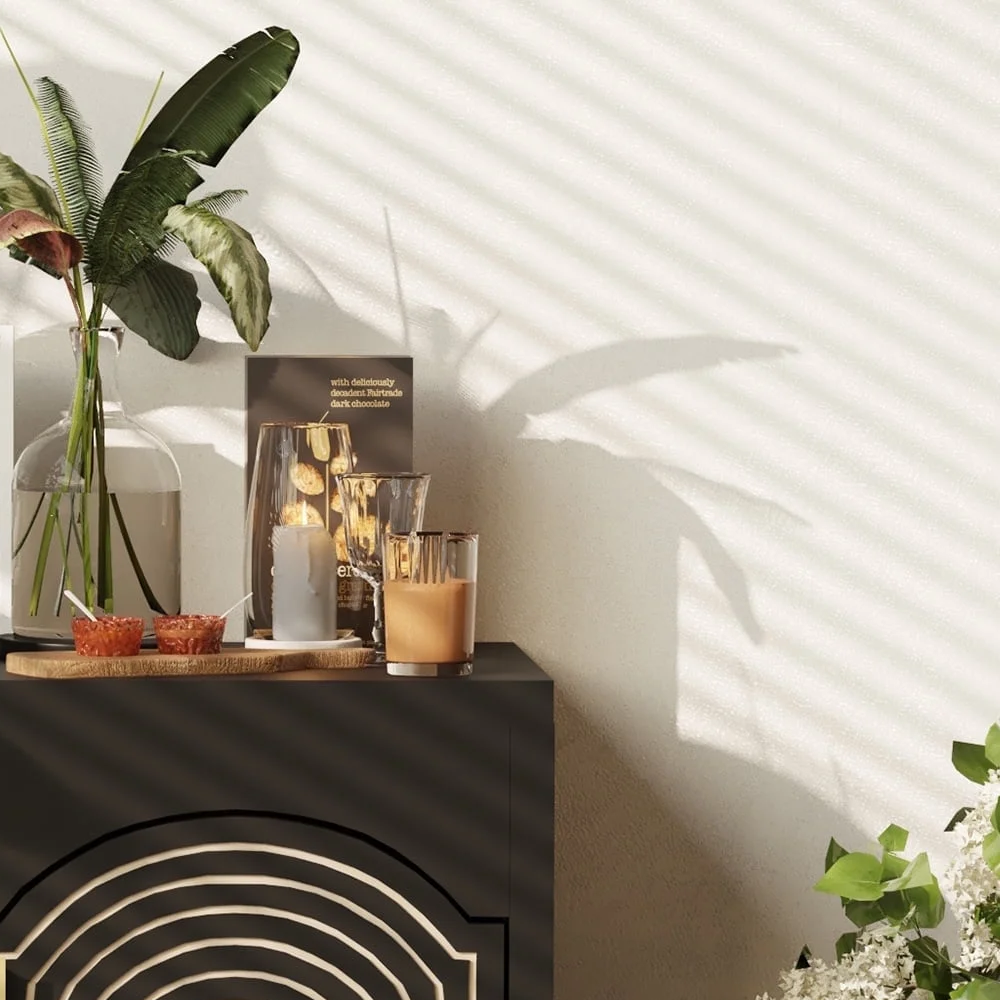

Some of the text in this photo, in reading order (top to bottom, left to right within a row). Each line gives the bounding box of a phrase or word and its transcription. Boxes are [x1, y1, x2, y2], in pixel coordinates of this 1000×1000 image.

[330, 378, 395, 388] with deliciously
[330, 389, 403, 397] decadent Fairtrade
[330, 400, 391, 408] dark chocolate
